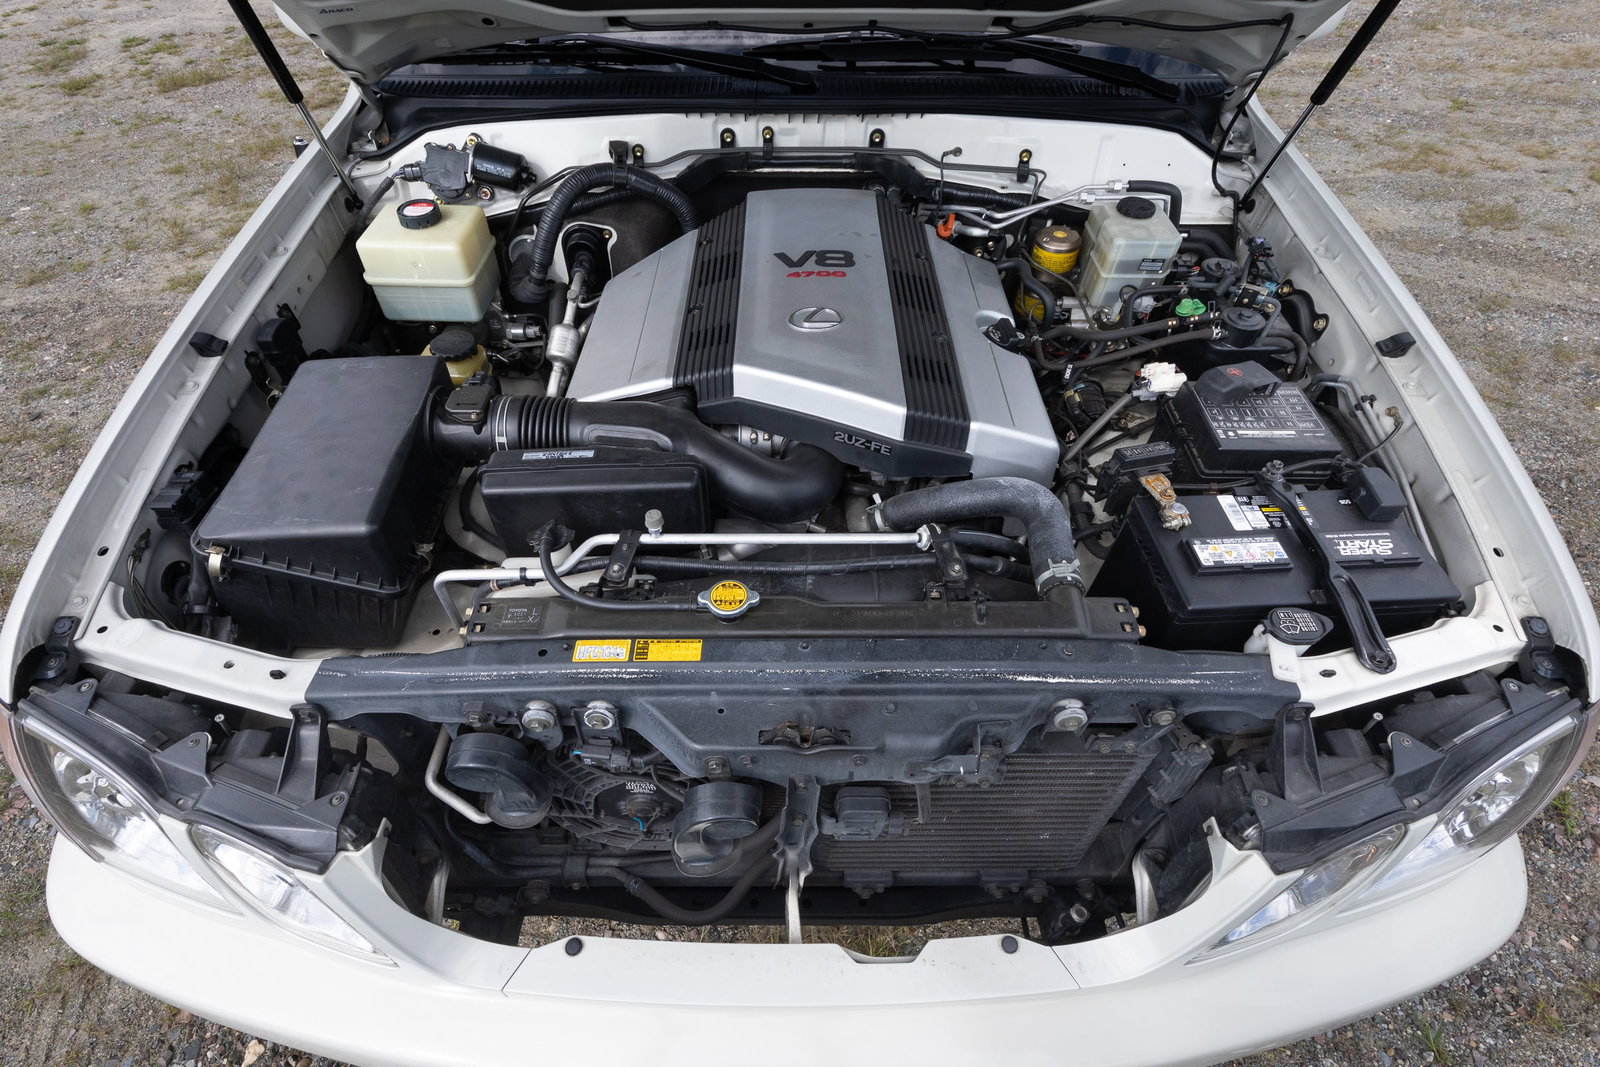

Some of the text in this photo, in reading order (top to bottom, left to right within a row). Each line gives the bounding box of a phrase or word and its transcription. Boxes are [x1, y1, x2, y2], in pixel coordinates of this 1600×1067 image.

[773, 249, 856, 268] V8
[785, 270, 847, 278] 4700
[834, 431, 891, 456] 2UZ-FE
